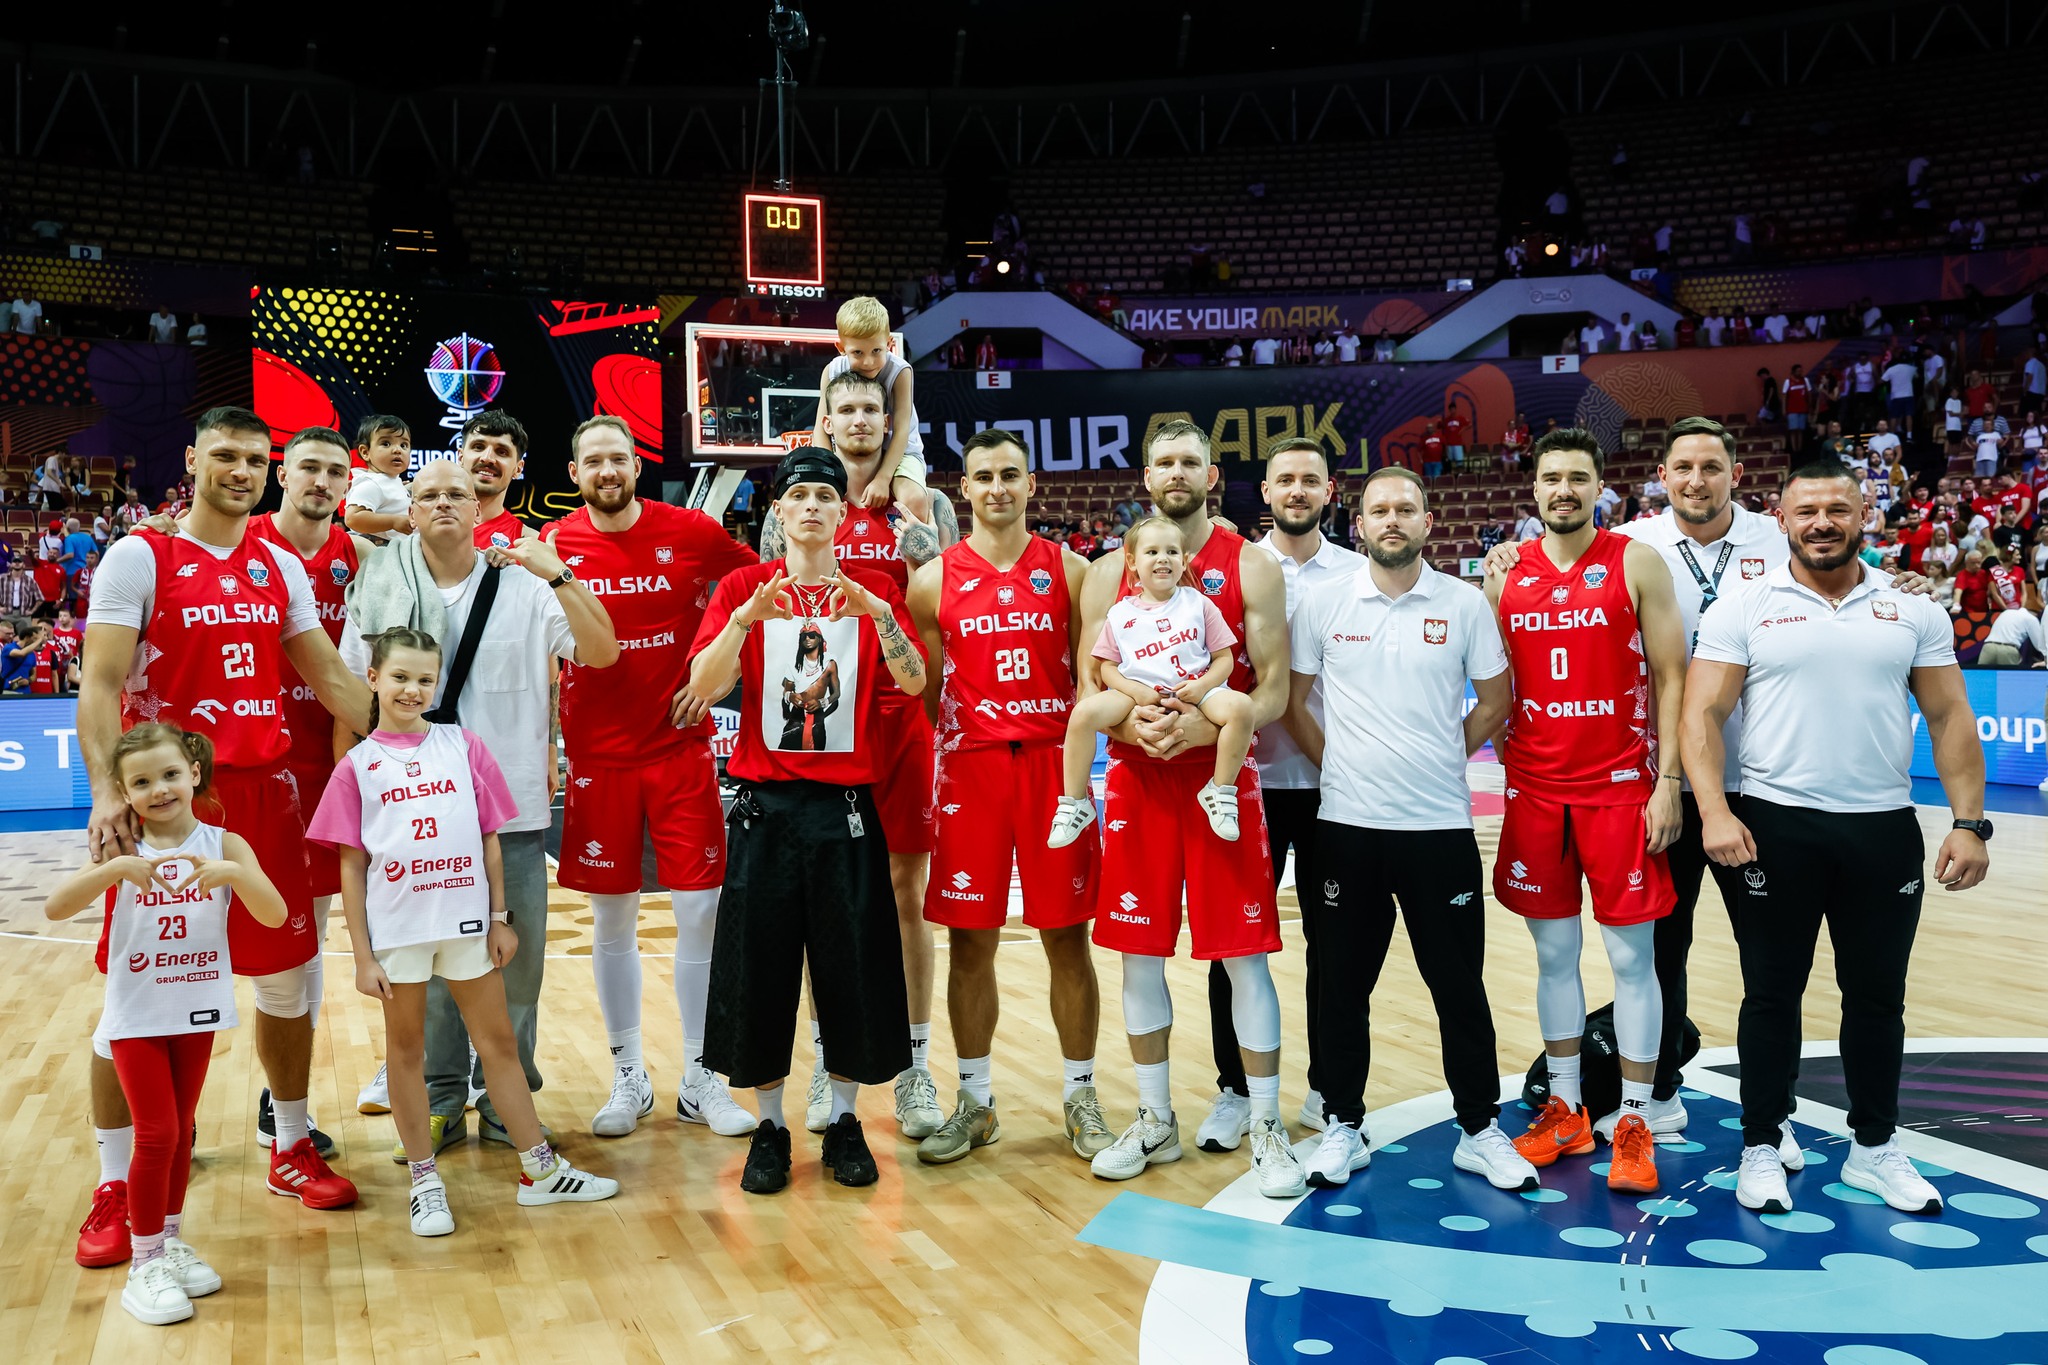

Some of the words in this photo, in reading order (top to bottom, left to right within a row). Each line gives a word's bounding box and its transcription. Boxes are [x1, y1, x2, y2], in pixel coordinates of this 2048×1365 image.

[766, 206, 800, 230] 0.0
[80, 247, 92, 259] D
[768, 284, 825, 298] TISSOT
[1186, 307, 1258, 330] YOUR
[1260, 305, 1340, 329] MARK
[1555, 357, 1566, 371] F
[988, 373, 1000, 387] E
[1876, 485, 1888, 495] 24
[565, 555, 585, 567] 4F
[1469, 561, 1478, 574] F
[176, 563, 199, 577] 4F
[959, 578, 981, 592] 4F
[1517, 576, 1540, 587] 4F
[181, 603, 280, 629] POLSKA
[1123, 617, 1137, 630] 4F
[1510, 607, 1609, 633] POLSKA
[1776, 615, 1807, 625] ORLEN
[959, 611, 1054, 638] POLSKA
[1134, 627, 1198, 660] POLSKA
[221, 642, 256, 680] 23
[995, 648, 1031, 682] 28
[1170, 654, 1188, 678] 3
[1550, 647, 1569, 681] 0
[1005, 697, 1067, 716] ORLEN
[1546, 699, 1615, 719] ORLEN
[1977, 716, 2047, 753] oup
[368, 760, 382, 771] 4F
[574, 777, 593, 788] 4F
[380, 779, 457, 807] POLSKA
[942, 803, 961, 816] 4F
[411, 817, 438, 841] 23
[1108, 819, 1128, 832] 4F
[411, 856, 472, 875] Energa
[578, 855, 615, 868] SUZUKI
[412, 881, 444, 893] GRUPA
[444, 877, 474, 889] ORLEN
[1507, 877, 1542, 894] UZUKI
[1899, 879, 1921, 895] 4F
[941, 889, 984, 902] SUZUKI
[1450, 891, 1474, 906] 4F
[1109, 911, 1150, 925] SUZUKI
[158, 915, 187, 940] 23
[155, 950, 218, 968] Energa
[156, 974, 186, 984] GRUPA
[188, 971, 218, 982] ORLEN
[1623, 1098, 1647, 1109] 4F
